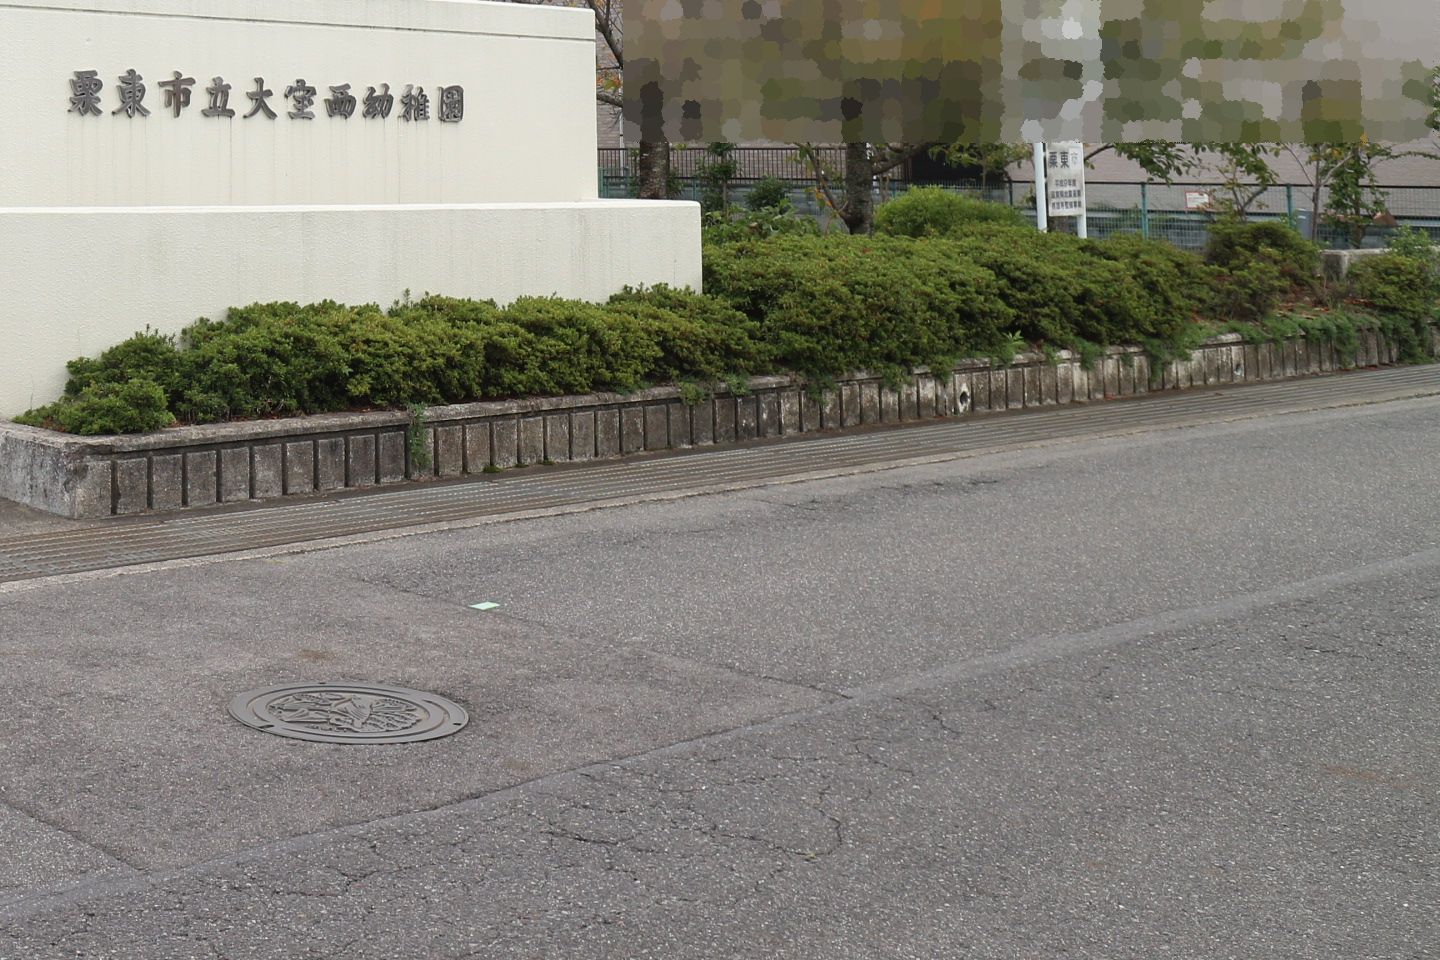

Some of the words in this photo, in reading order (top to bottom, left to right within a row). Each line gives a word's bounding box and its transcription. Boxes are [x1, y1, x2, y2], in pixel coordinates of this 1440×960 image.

[67, 69, 465, 123] 栗東市立大宝西幼稚園
